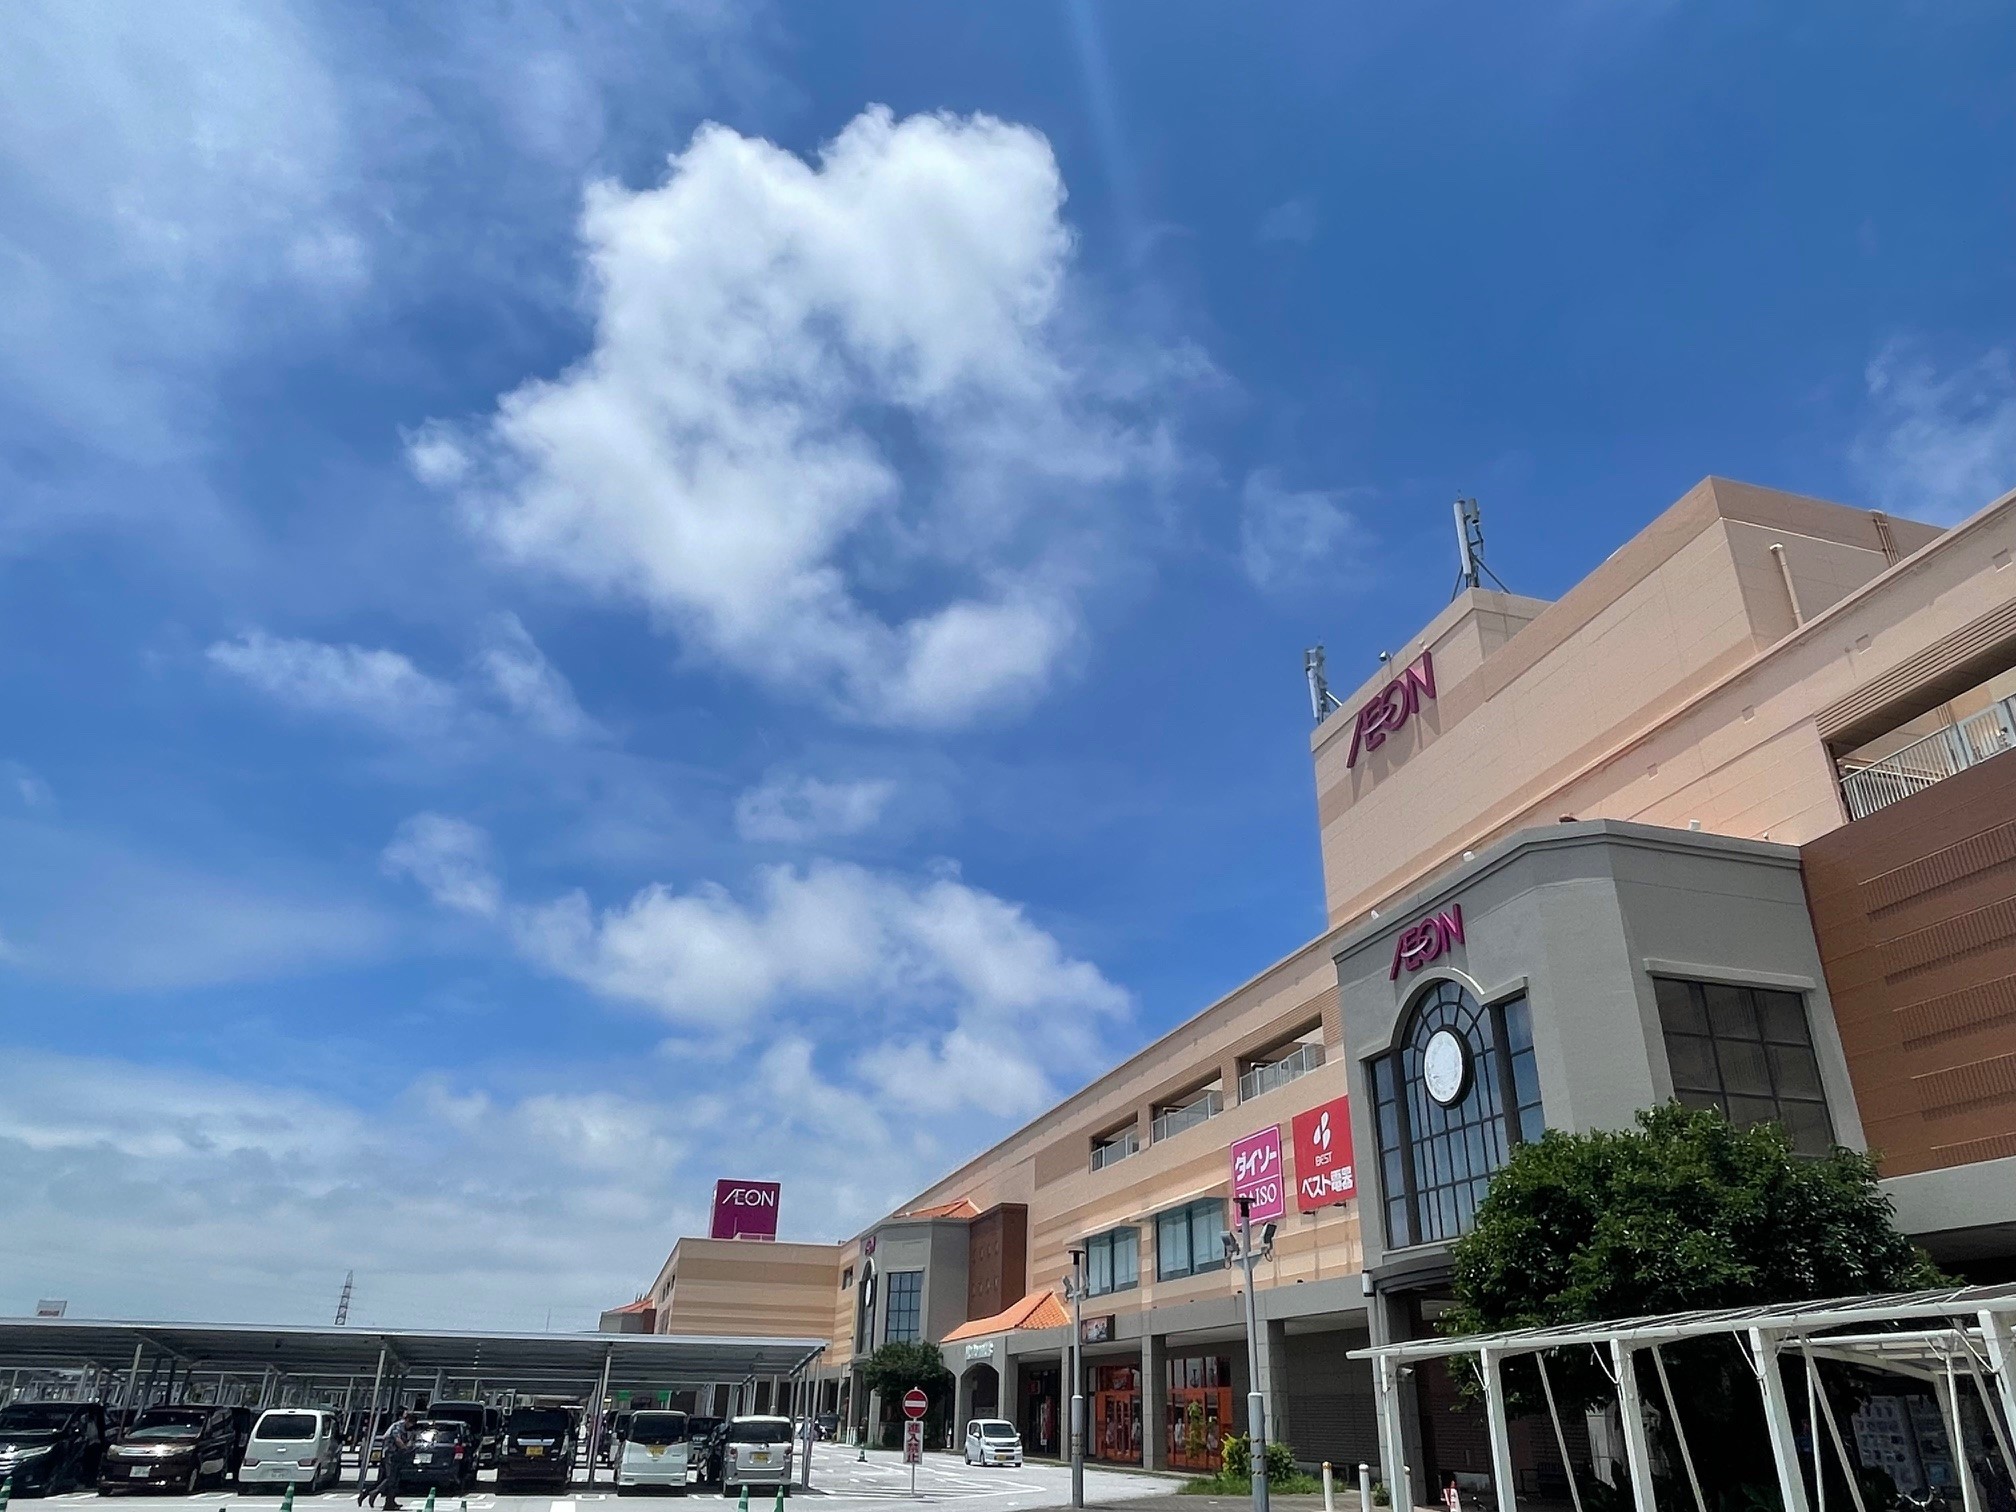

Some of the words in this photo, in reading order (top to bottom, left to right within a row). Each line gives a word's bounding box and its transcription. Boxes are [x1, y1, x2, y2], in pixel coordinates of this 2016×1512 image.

[1235, 1145, 1277, 1182] ダイソー
[1315, 1151, 1333, 1167] BEST
[1239, 1183, 1277, 1209] AISO
[1301, 1166, 1353, 1198] ベスト電器
